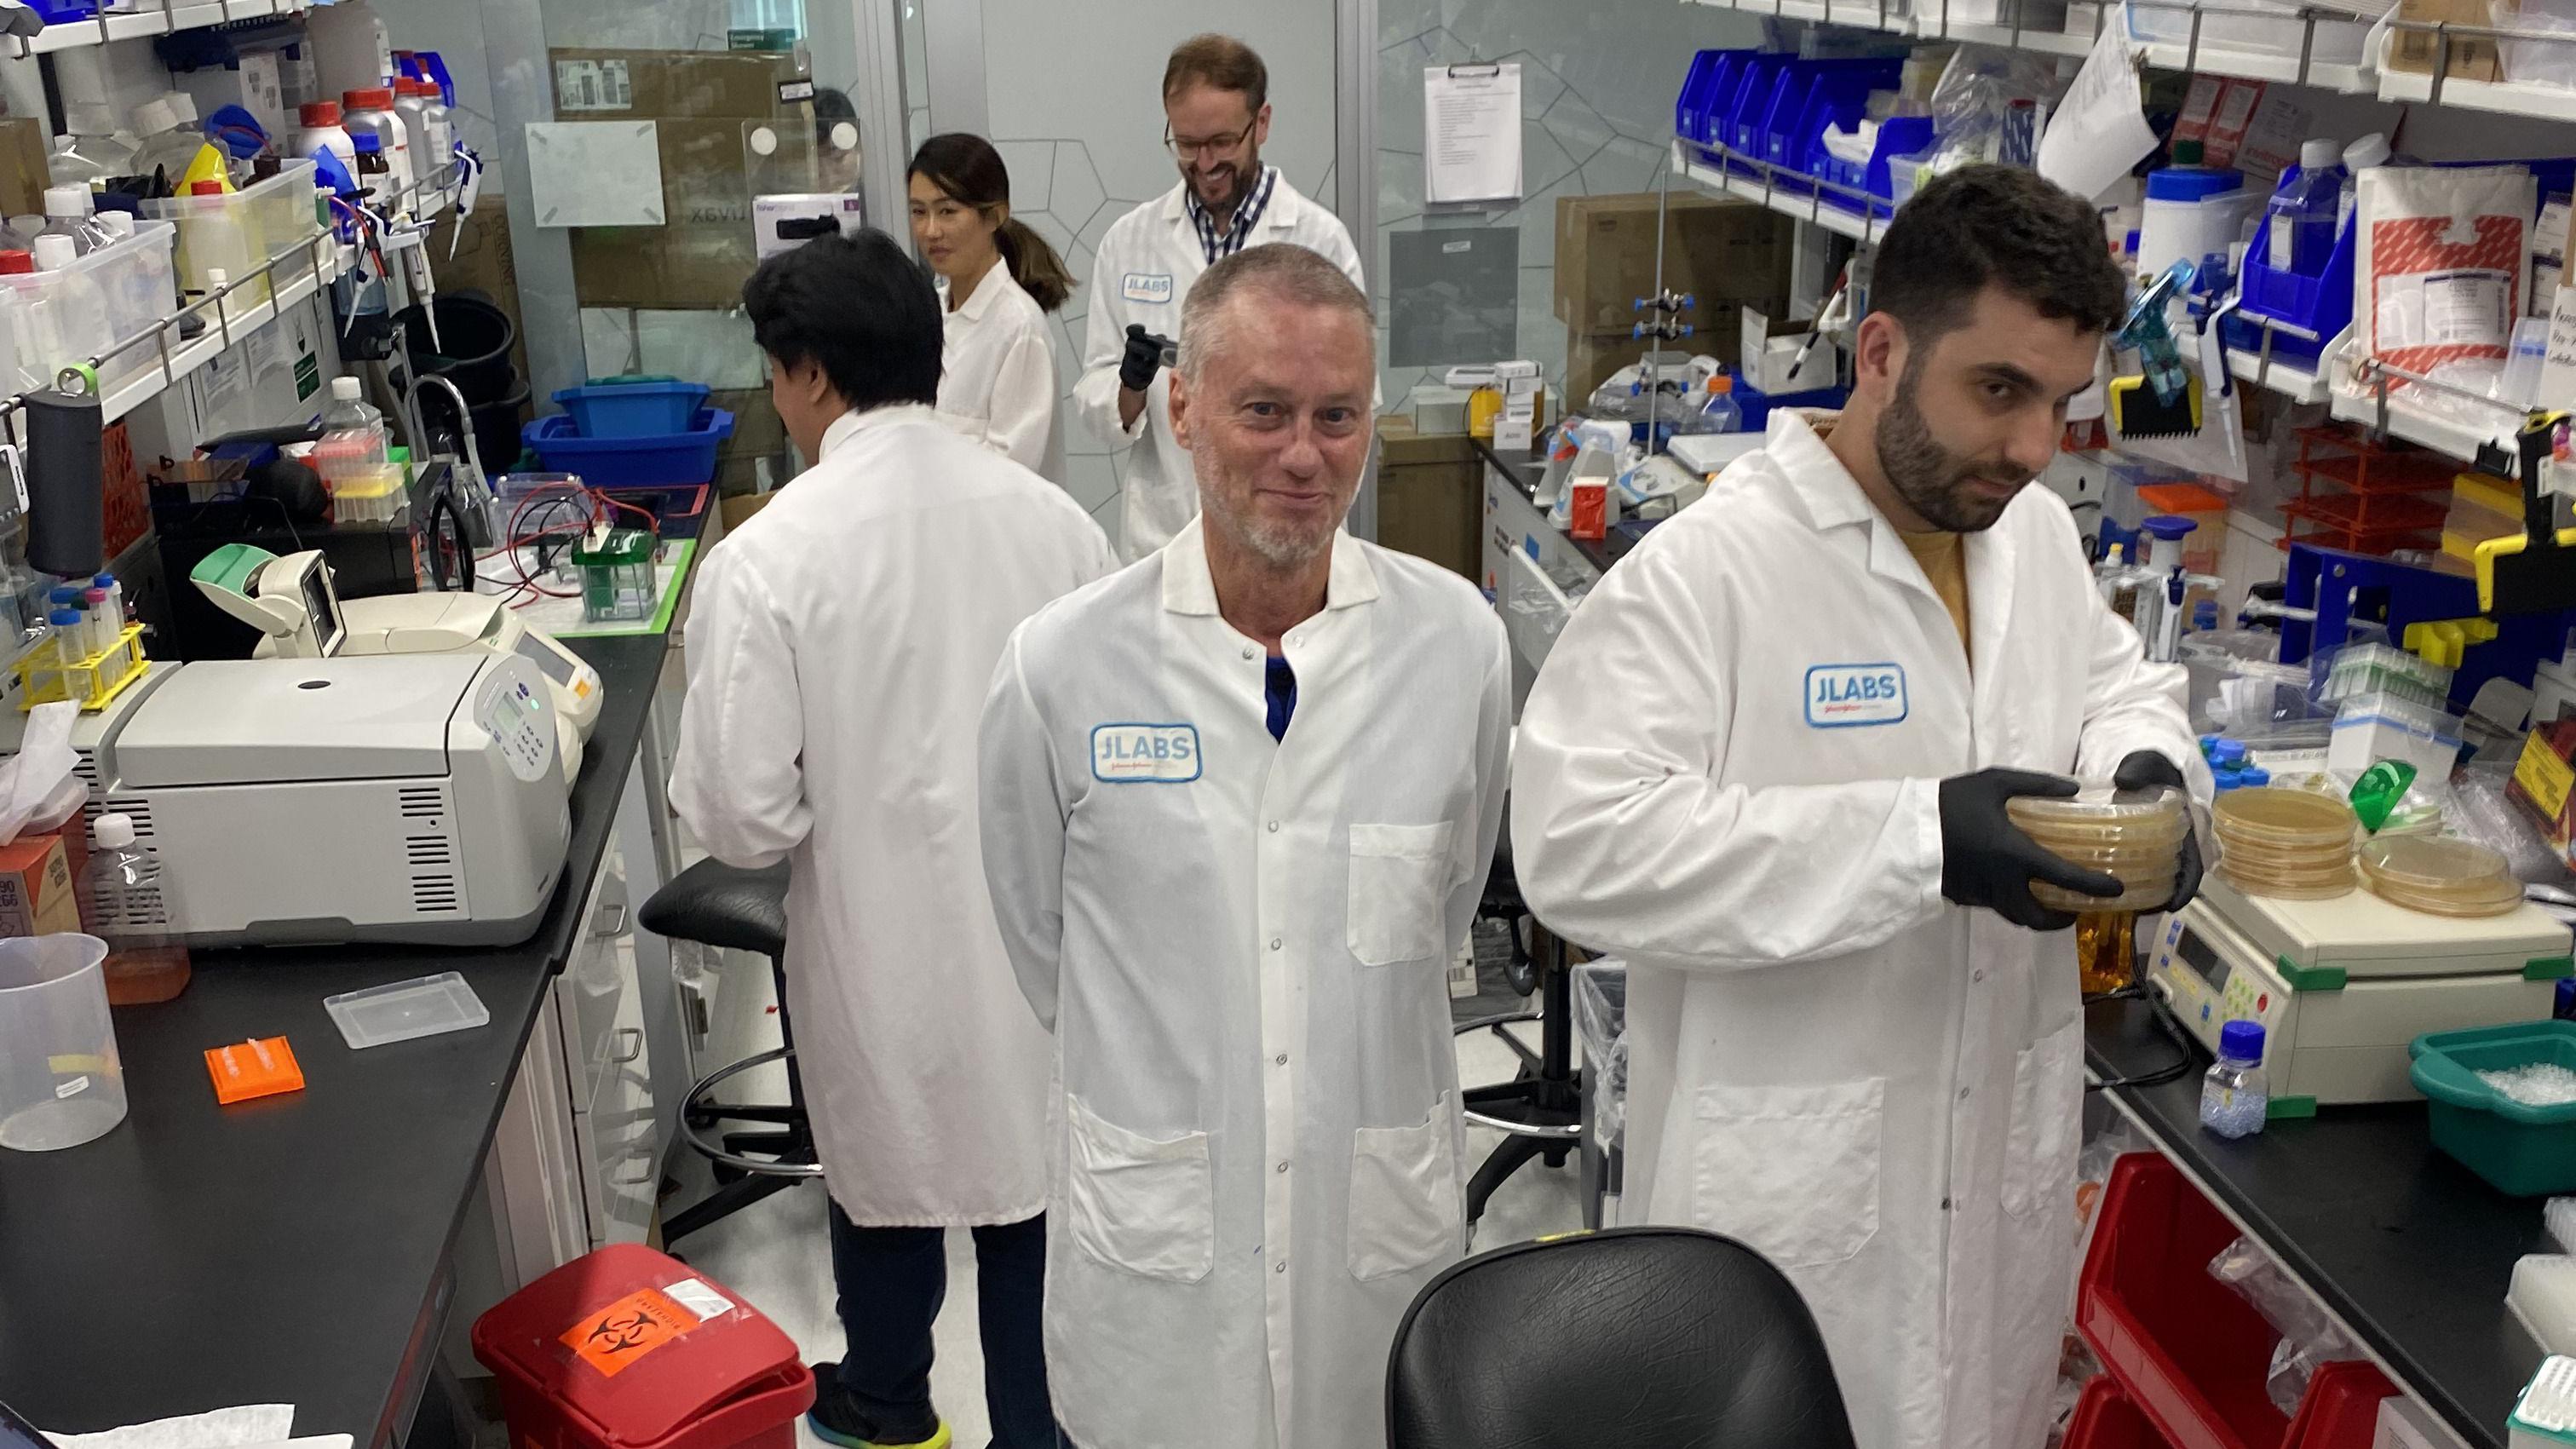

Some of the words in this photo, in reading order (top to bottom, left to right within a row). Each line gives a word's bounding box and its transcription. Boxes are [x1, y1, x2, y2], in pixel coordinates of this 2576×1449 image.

[1128, 278, 1169, 292] JLABS
[1816, 674, 1896, 703] JLABS
[1102, 735, 1191, 760] JLABS
